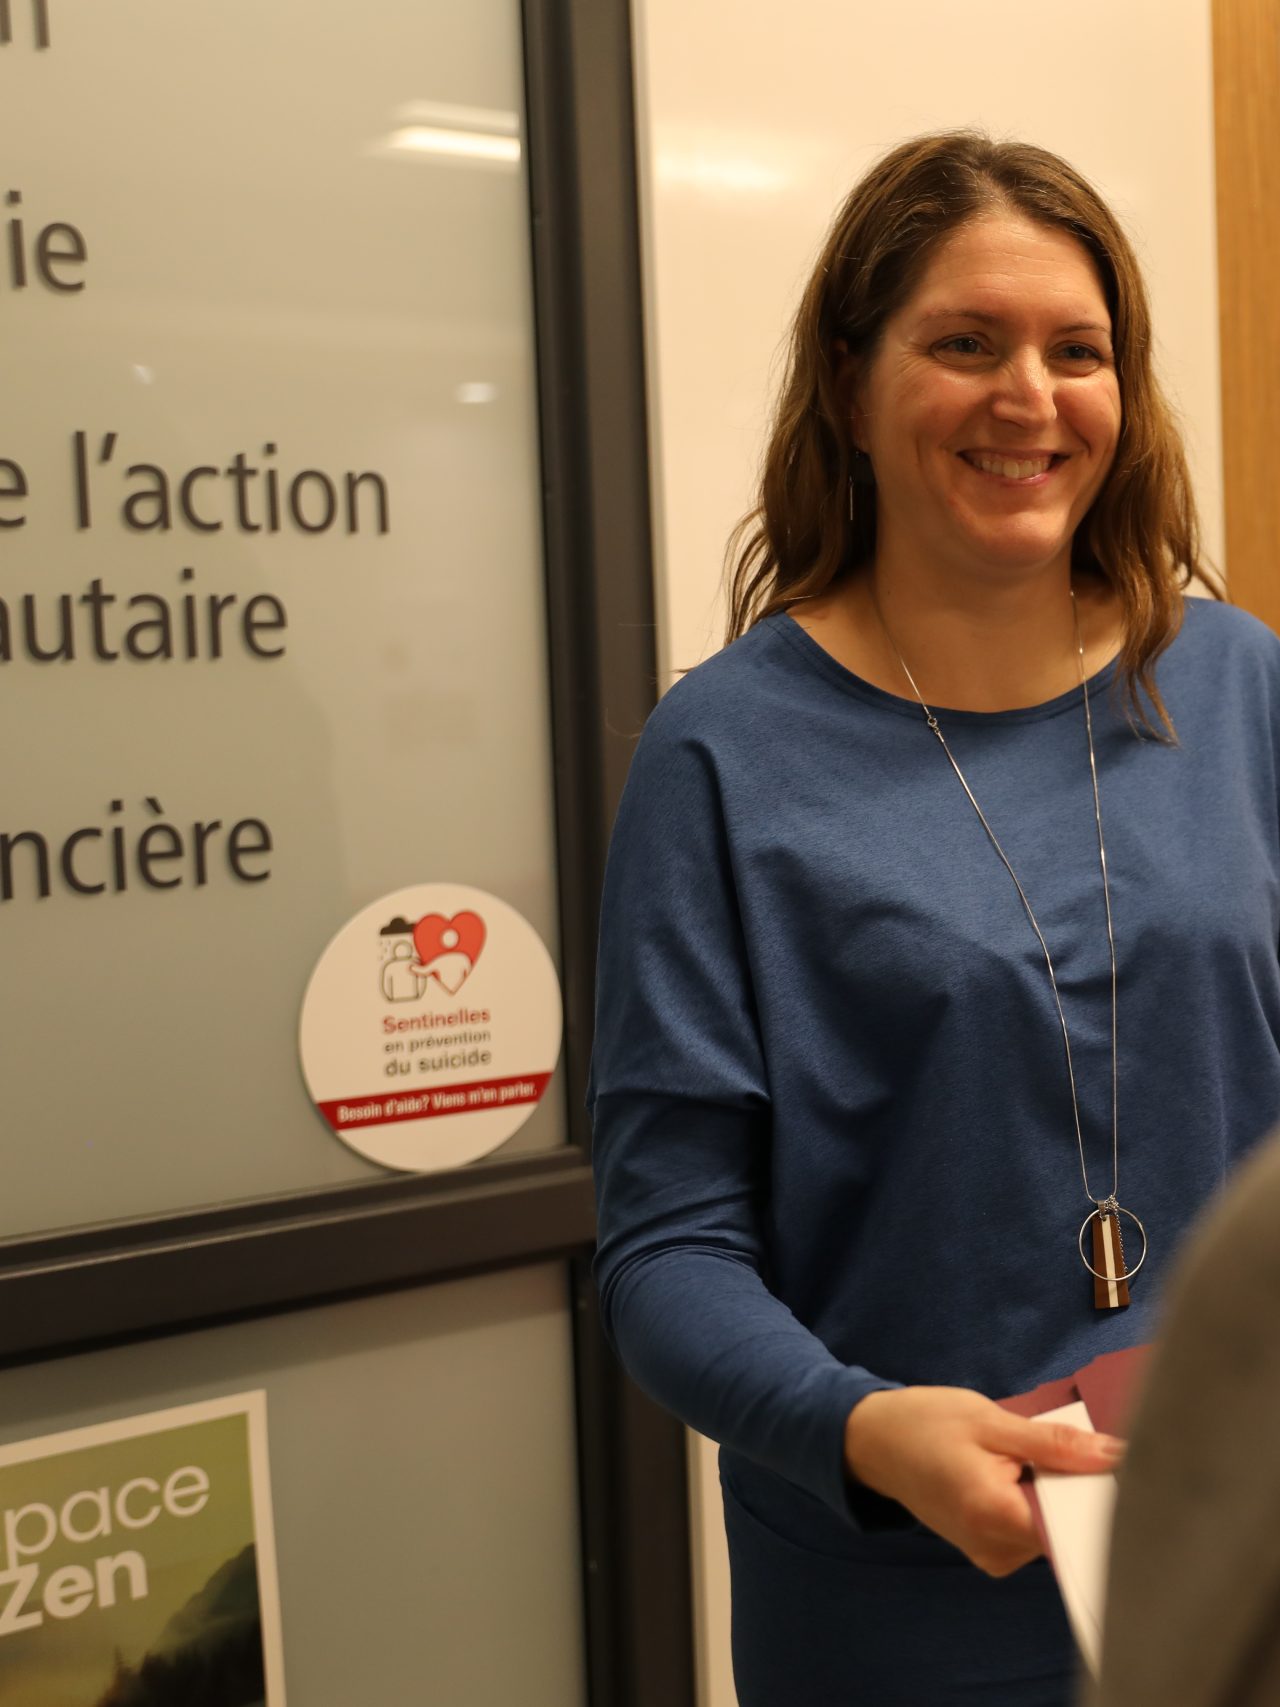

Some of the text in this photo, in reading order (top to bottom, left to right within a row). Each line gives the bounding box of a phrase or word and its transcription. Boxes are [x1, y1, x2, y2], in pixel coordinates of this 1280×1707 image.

[0, 567, 288, 662] utaire
[0, 797, 273, 900] ncière
[383, 1008, 490, 1034] Sentinelles
[385, 1030, 491, 1054] en prévention
[385, 1048, 492, 1077] du suicide
[336, 1104, 383, 1123] Besoin
[432, 1091, 467, 1110] Viens
[5, 1465, 210, 1570] pace
